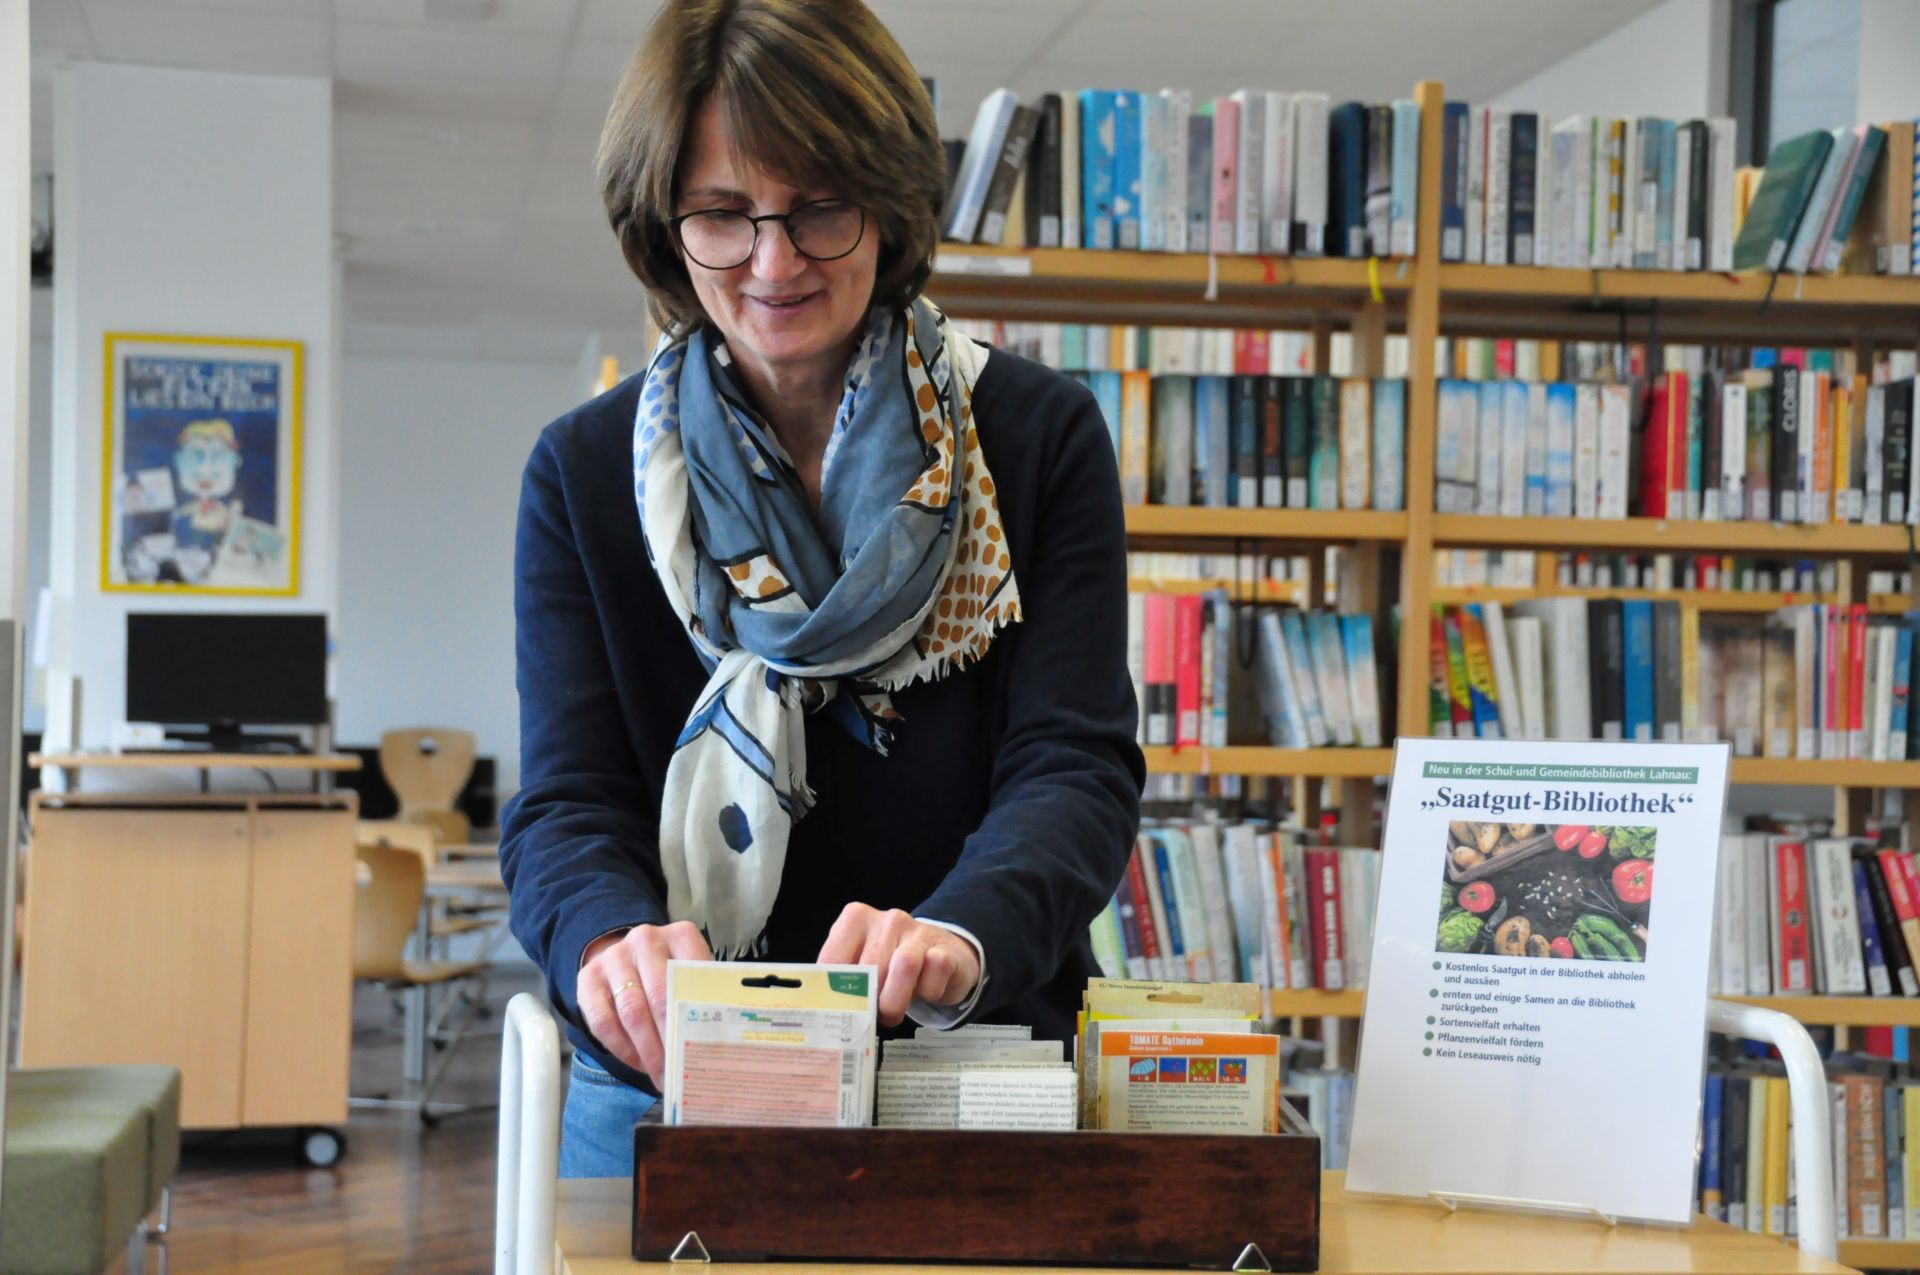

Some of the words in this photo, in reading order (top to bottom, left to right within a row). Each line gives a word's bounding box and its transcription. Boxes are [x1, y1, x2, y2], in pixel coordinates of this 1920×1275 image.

[1429, 764, 1449, 775] Neu
[1452, 764, 1462, 776] in
[1465, 765, 1482, 777] der
[1485, 765, 1537, 778] Schul-und
[1540, 767, 1646, 780] Gemeindebibliothek
[1650, 769, 1692, 781] Lahnau:
[1420, 787, 1694, 815] „Saatgut-Bibliothek“
[1446, 962, 1489, 974] Kostenlos
[1492, 964, 1526, 976] Saatgut
[1529, 965, 1537, 975] in
[1540, 966, 1555, 976] der
[1558, 967, 1604, 979] Bibliothek
[1608, 970, 1645, 981] abholen
[1444, 974, 1461, 984] und
[1464, 976, 1499, 986] aussäen
[1442, 991, 1471, 1001] ernten
[1473, 991, 1491, 1001] und
[1494, 992, 1521, 1004] einige
[1524, 994, 1554, 1004] Samen
[1557, 997, 1568, 1005] an
[1571, 996, 1585, 1006] die
[1589, 998, 1635, 1009] Bibliothek
[1440, 1003, 1499, 1015] zurückgeben
[1440, 1017, 1500, 1029] Sortenvielfalt
[1503, 1021, 1541, 1032] erhalten
[1130, 1034, 1160, 1045] TOMATE
[1162, 1034, 1204, 1046] Dattelwein
[1438, 1033, 1507, 1046] Pflanzenvielfalt
[1510, 1036, 1544, 1048] fördern
[1436, 1048, 1455, 1058] Kein
[1458, 1049, 1514, 1062] Leseausweis
[1517, 1053, 1541, 1065] nötig
